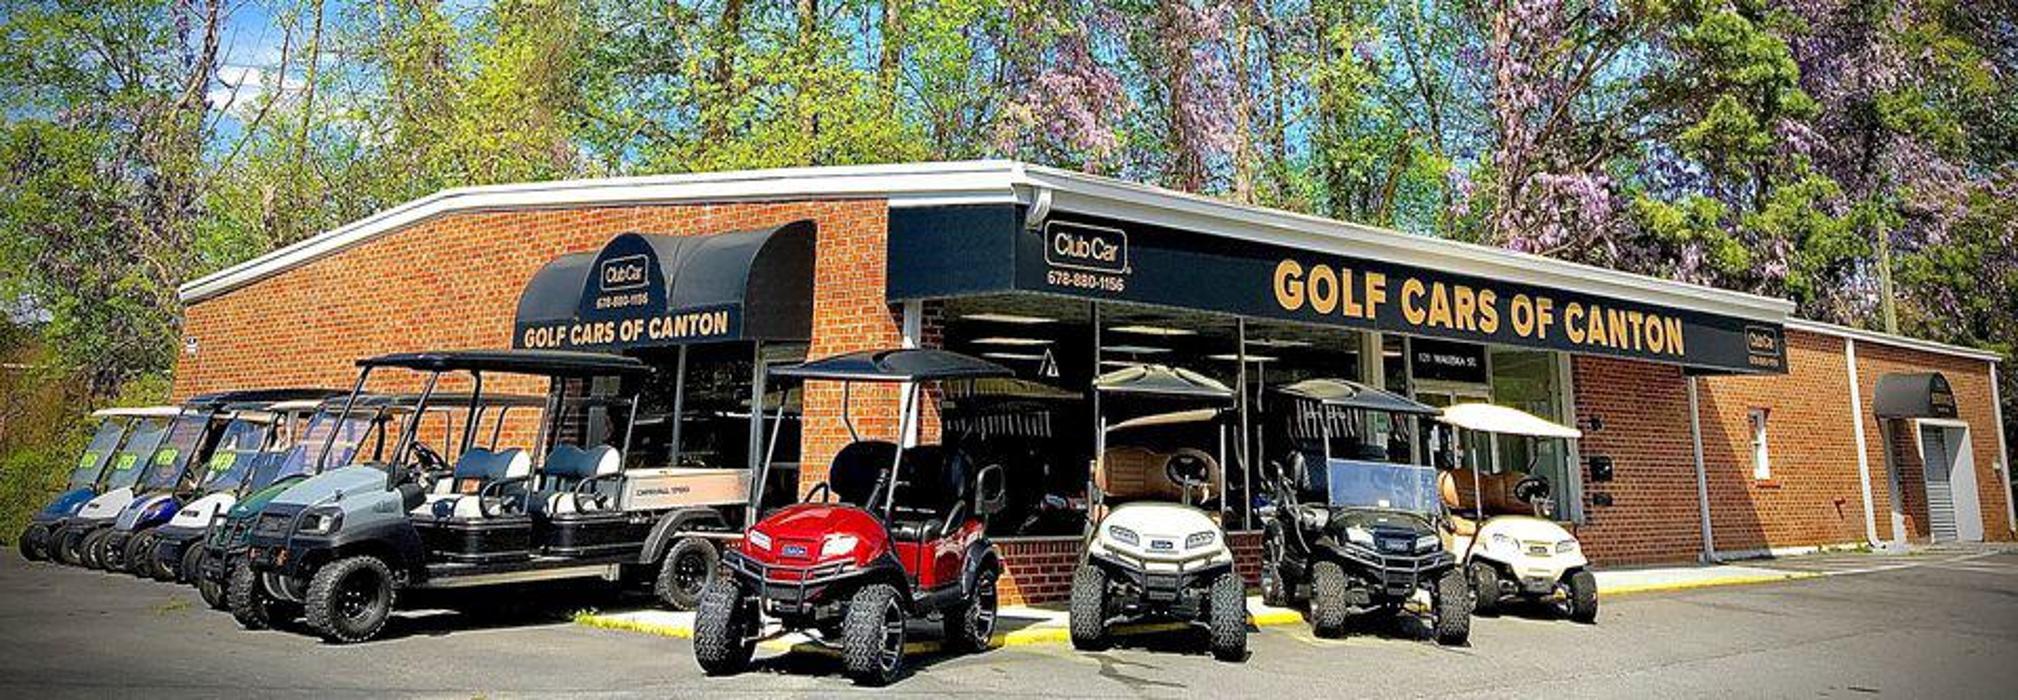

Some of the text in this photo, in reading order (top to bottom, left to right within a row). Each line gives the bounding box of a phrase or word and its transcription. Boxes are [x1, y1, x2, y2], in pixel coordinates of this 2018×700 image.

[1055, 233, 1119, 262] Club Car
[605, 264, 643, 282] Club Car
[1047, 270, 1125, 292] 678-880-1156
[1274, 258, 1686, 356] GOLF CARS OF CANTON
[524, 310, 729, 348] GOLF CARS OF CANTON
